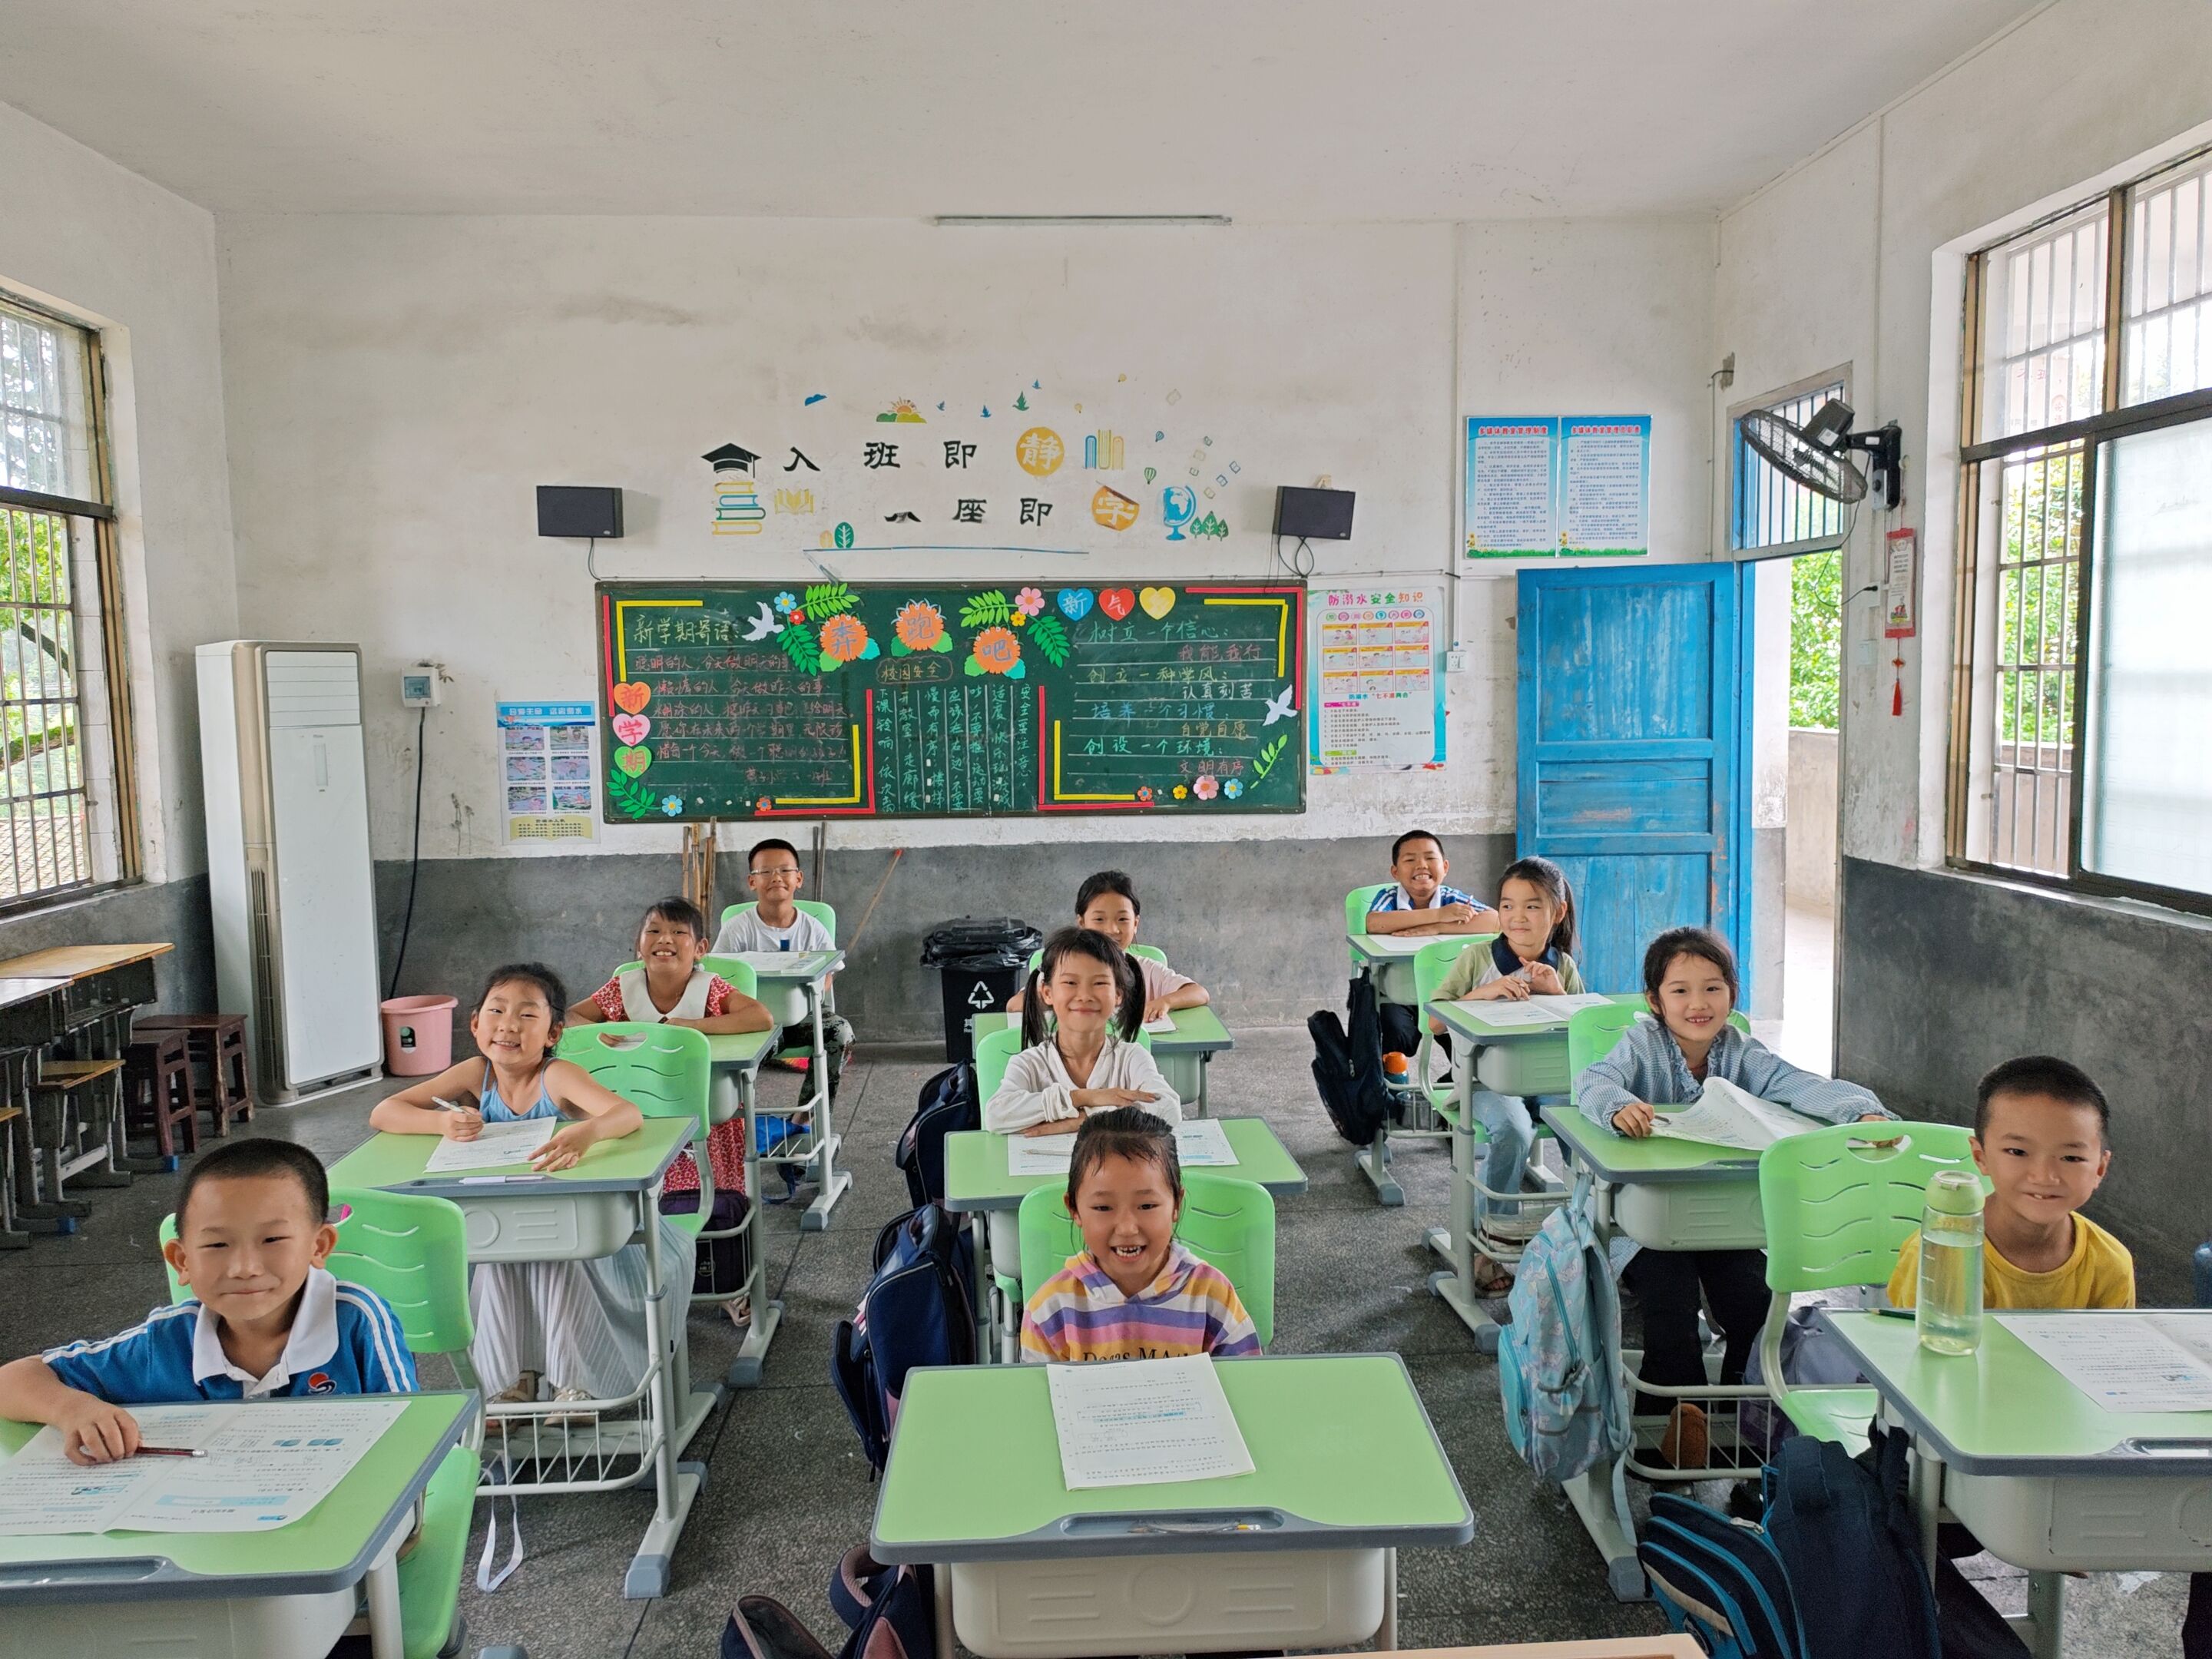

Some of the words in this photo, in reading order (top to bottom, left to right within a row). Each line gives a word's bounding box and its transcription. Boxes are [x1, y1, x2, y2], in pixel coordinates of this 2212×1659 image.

[783, 433, 1061, 472] 入班即静
[1328, 591, 1424, 606] 防溺水安全知识
[881, 661, 942, 683] 校园安全
[1182, 681, 1253, 700] 认真刻苦
[618, 690, 647, 774] 新学期
[1180, 720, 1250, 741] 自觉自愿
[1178, 759, 1246, 776] 文明有序
